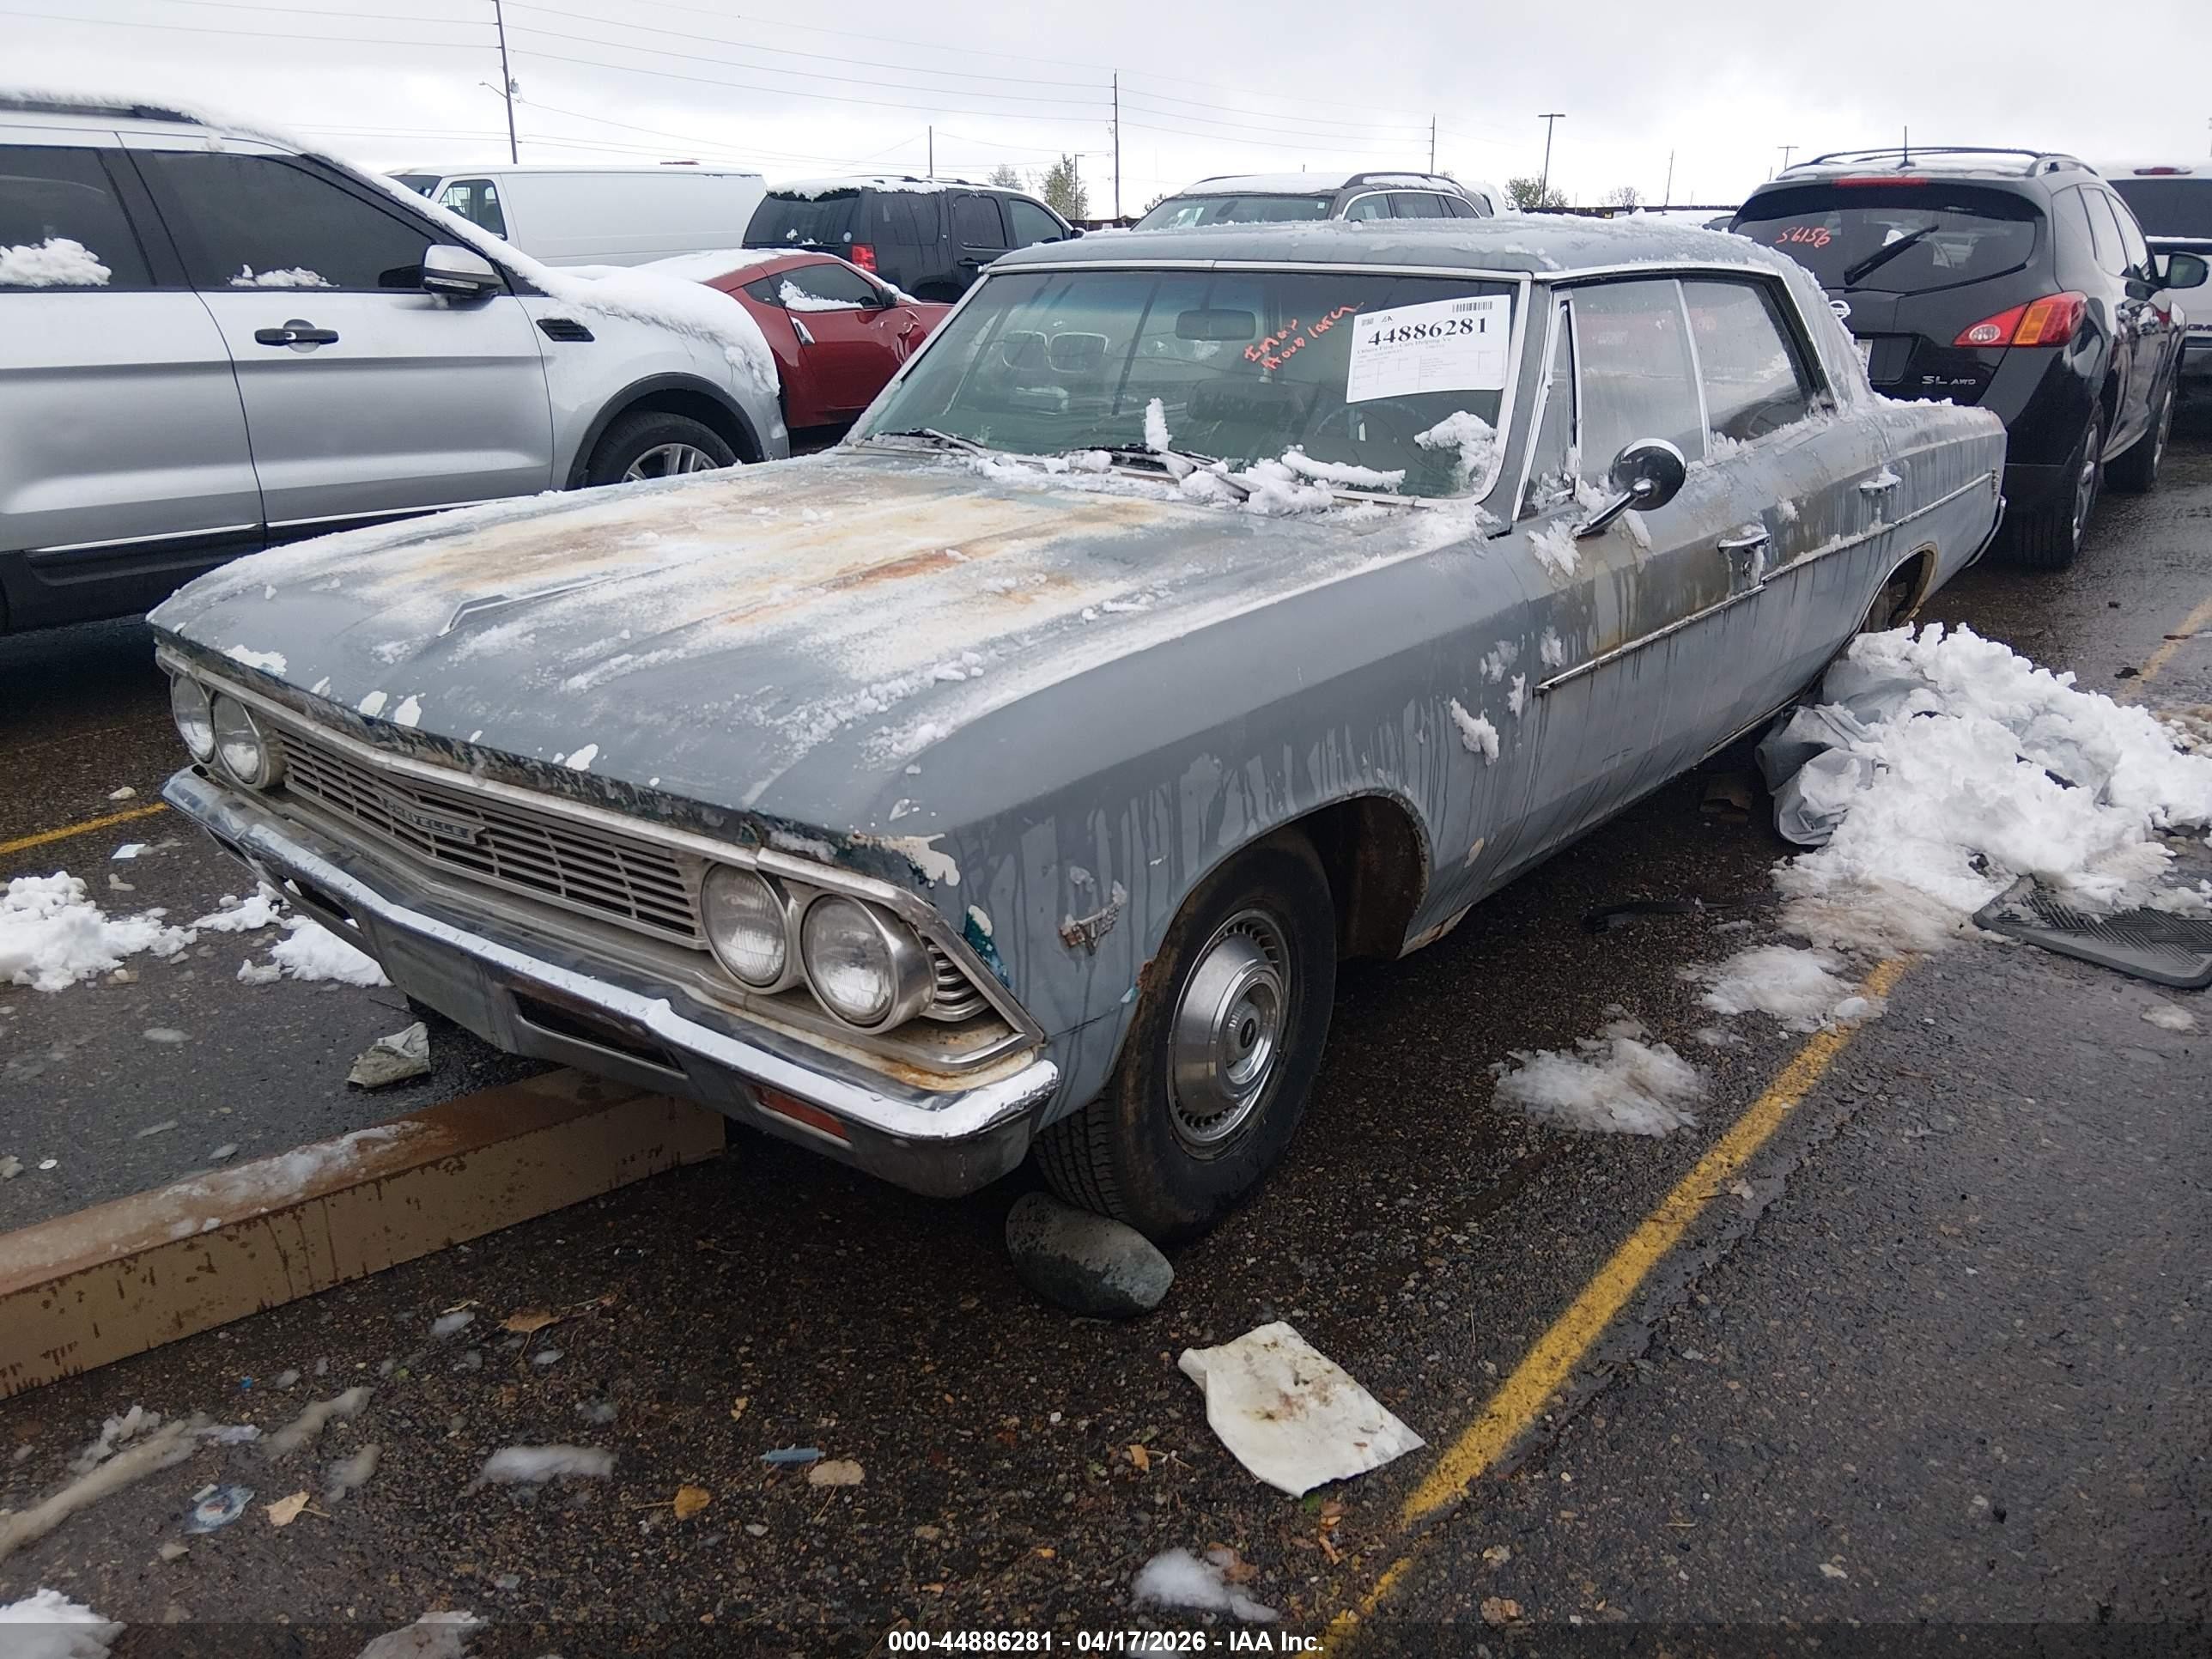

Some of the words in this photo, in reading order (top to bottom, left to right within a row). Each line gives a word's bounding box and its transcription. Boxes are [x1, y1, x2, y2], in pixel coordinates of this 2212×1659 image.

[1775, 226, 1832, 248] 56156
[1368, 317, 1487, 346] 44886281
[1922, 375, 1948, 385] SL
